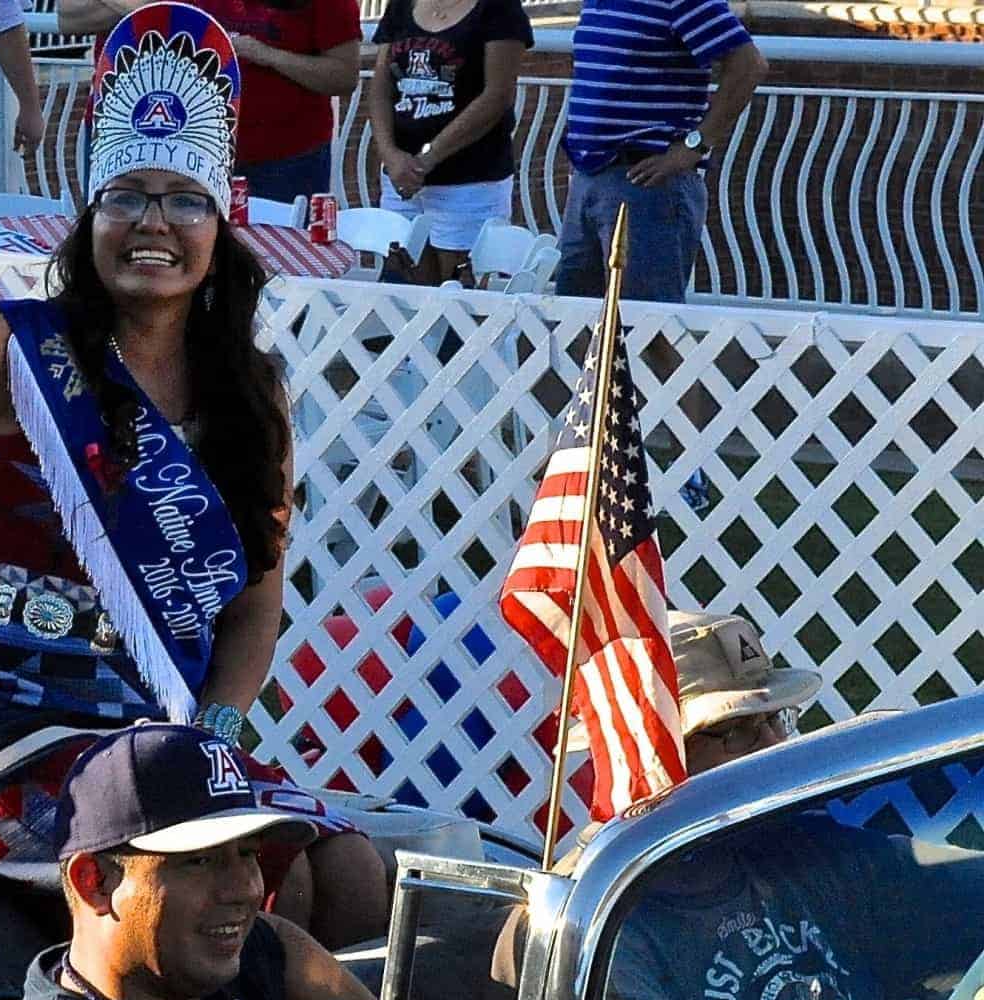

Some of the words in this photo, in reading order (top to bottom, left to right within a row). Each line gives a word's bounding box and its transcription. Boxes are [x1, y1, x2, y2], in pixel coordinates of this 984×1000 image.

[136, 95, 180, 131] A
[186, 150, 205, 172] OF
[136, 463, 208, 553] Native
[199, 741, 252, 797] A
